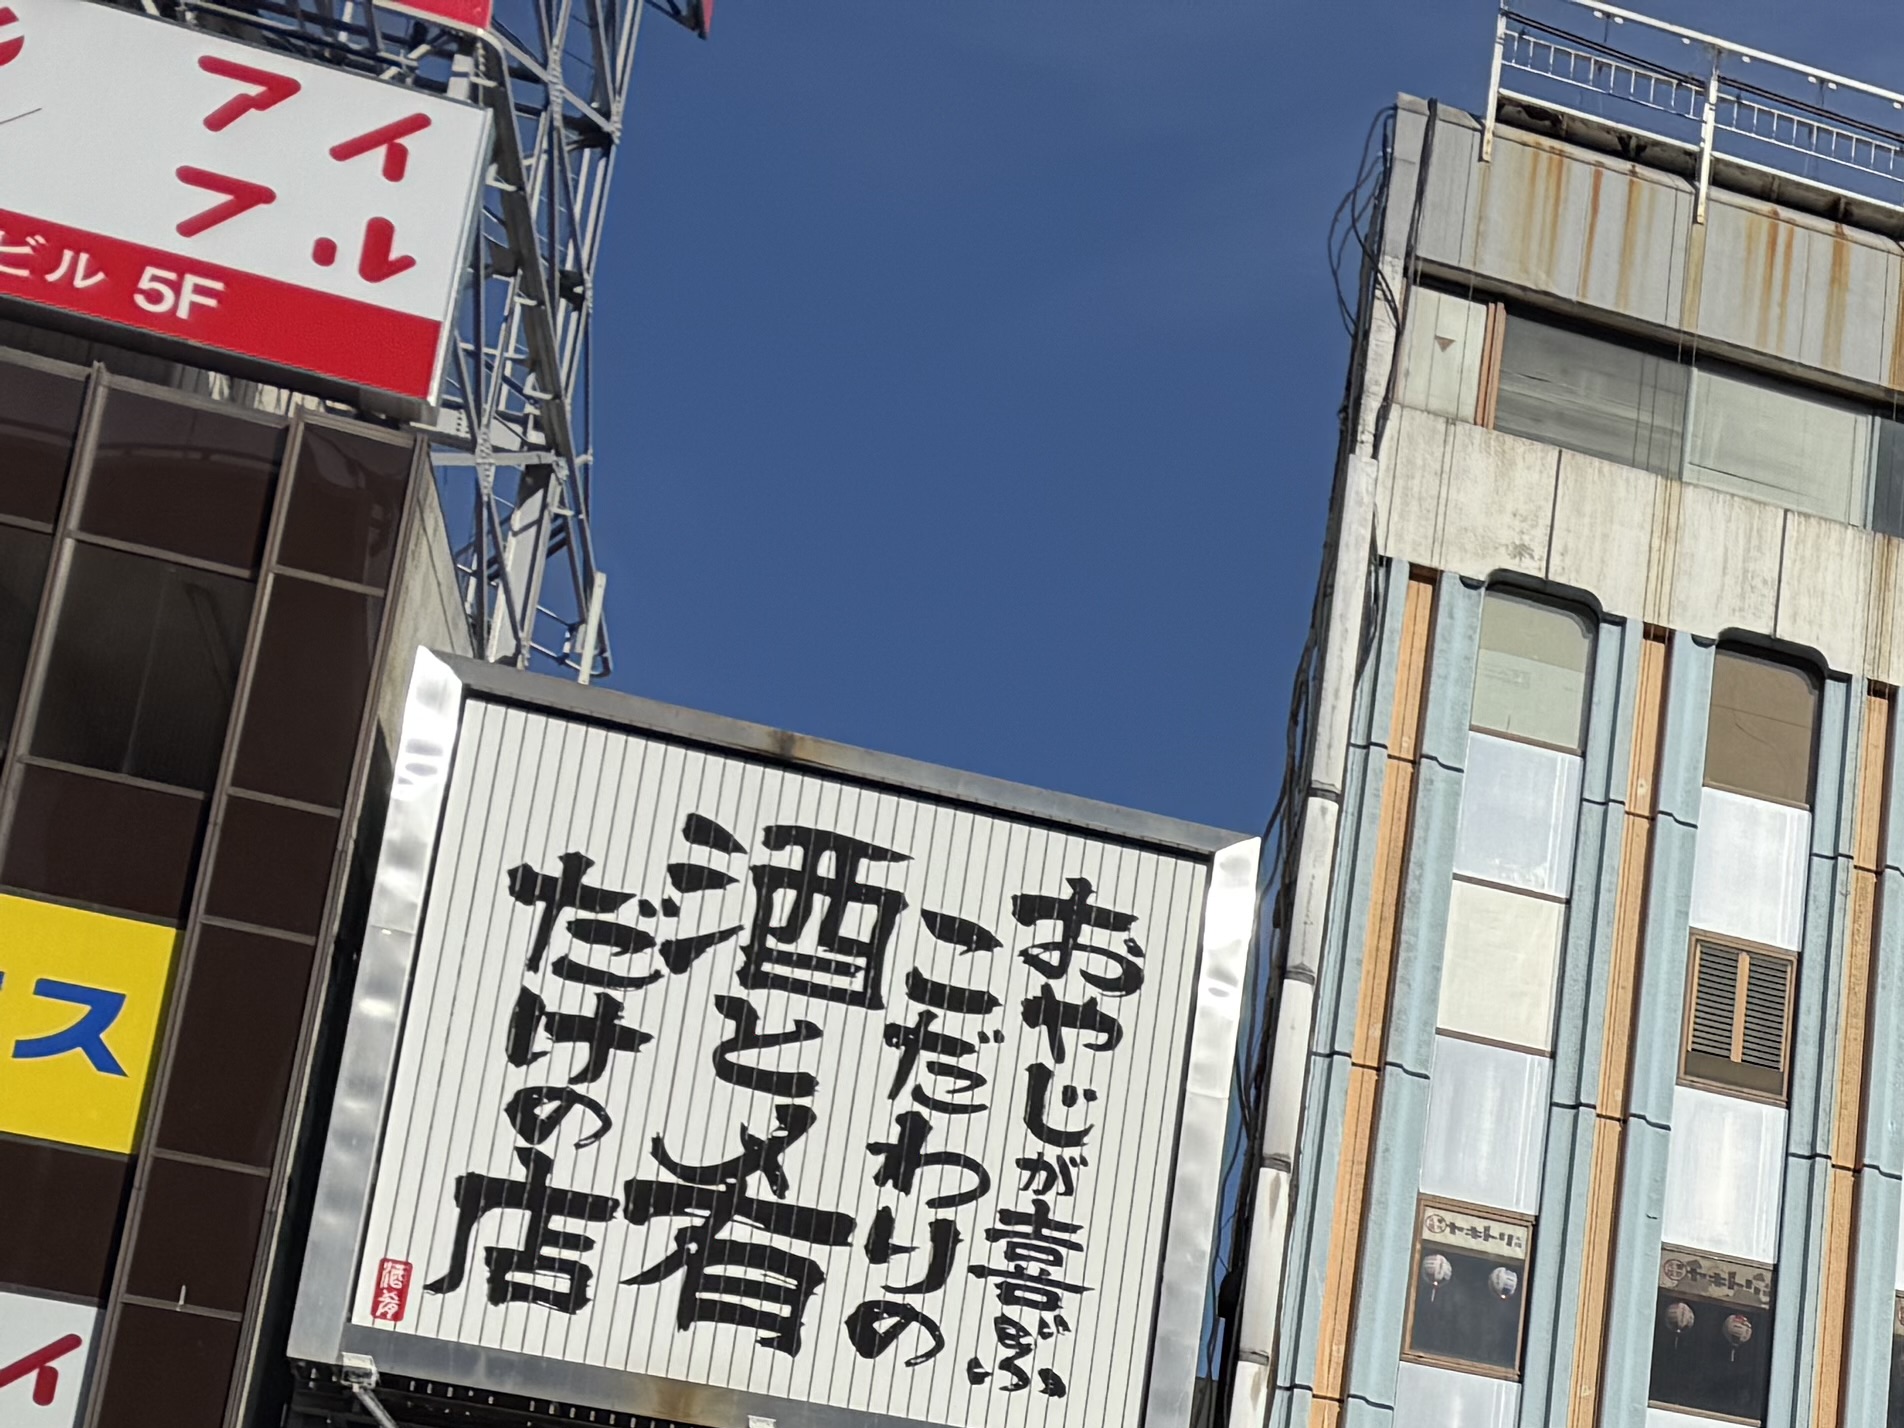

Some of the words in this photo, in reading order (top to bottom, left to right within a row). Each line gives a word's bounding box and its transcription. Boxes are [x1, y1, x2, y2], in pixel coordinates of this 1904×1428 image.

[133, 265, 227, 321] 5F
[423, 850, 681, 1315] だけの店
[620, 811, 916, 1358] 酒と肴
[844, 908, 1005, 1368] こだわりの
[966, 877, 1146, 1399] おやじが喜ぶ
